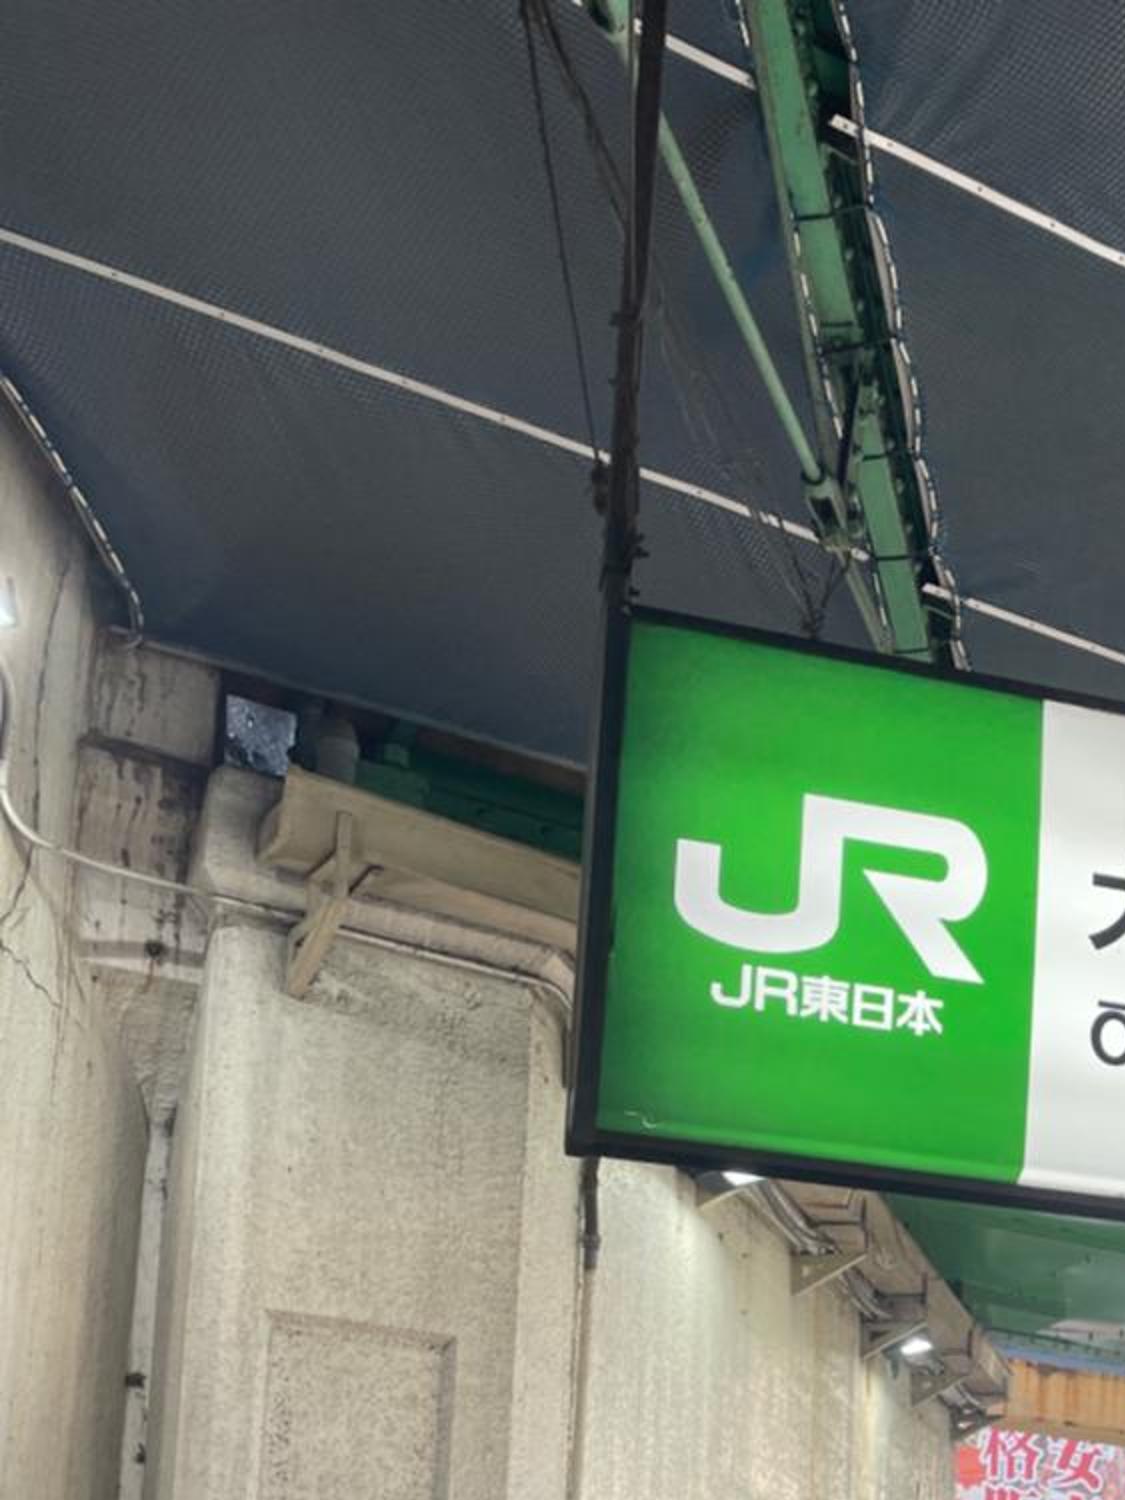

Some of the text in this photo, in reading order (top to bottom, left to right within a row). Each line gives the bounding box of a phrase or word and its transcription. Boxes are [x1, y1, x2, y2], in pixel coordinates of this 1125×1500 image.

[674, 793, 988, 985] JR
[710, 963, 944, 1036] JR東日本
